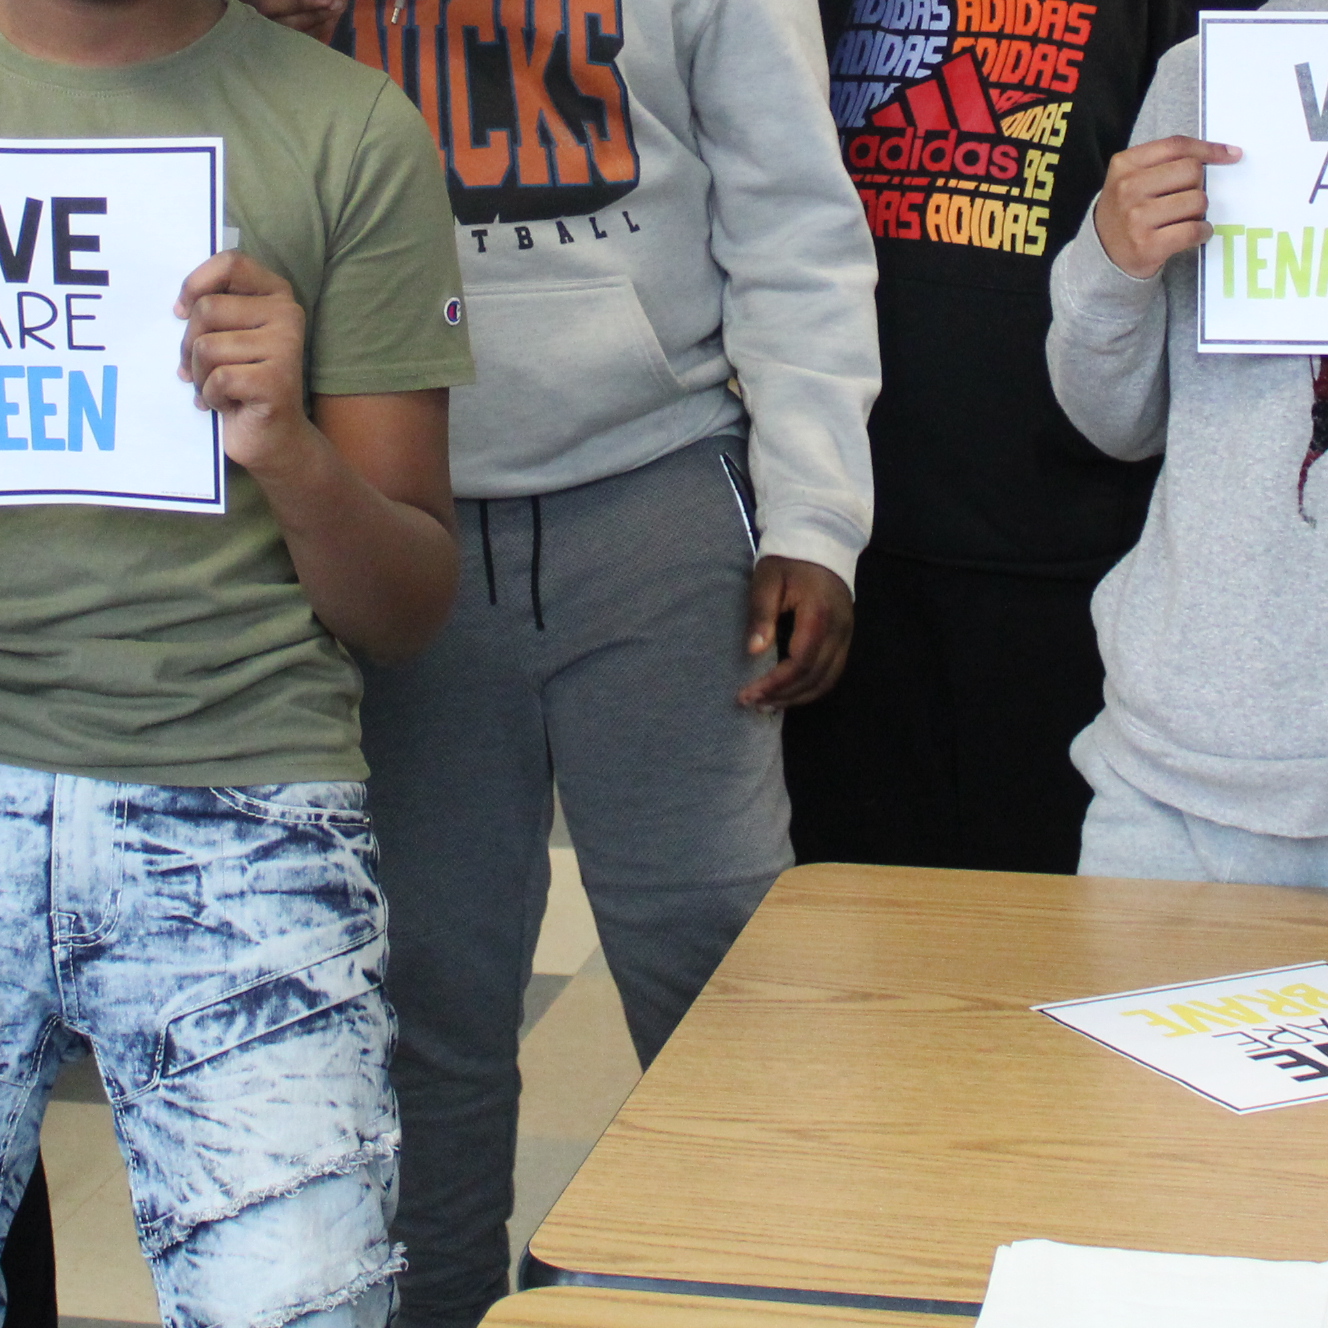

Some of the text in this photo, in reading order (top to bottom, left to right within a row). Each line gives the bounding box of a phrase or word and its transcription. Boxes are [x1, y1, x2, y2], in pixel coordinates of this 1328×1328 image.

[849, 126, 1019, 179] adidas
[471, 211, 640, 253] TBALL
[926, 192, 1050, 256] ADIDAS
